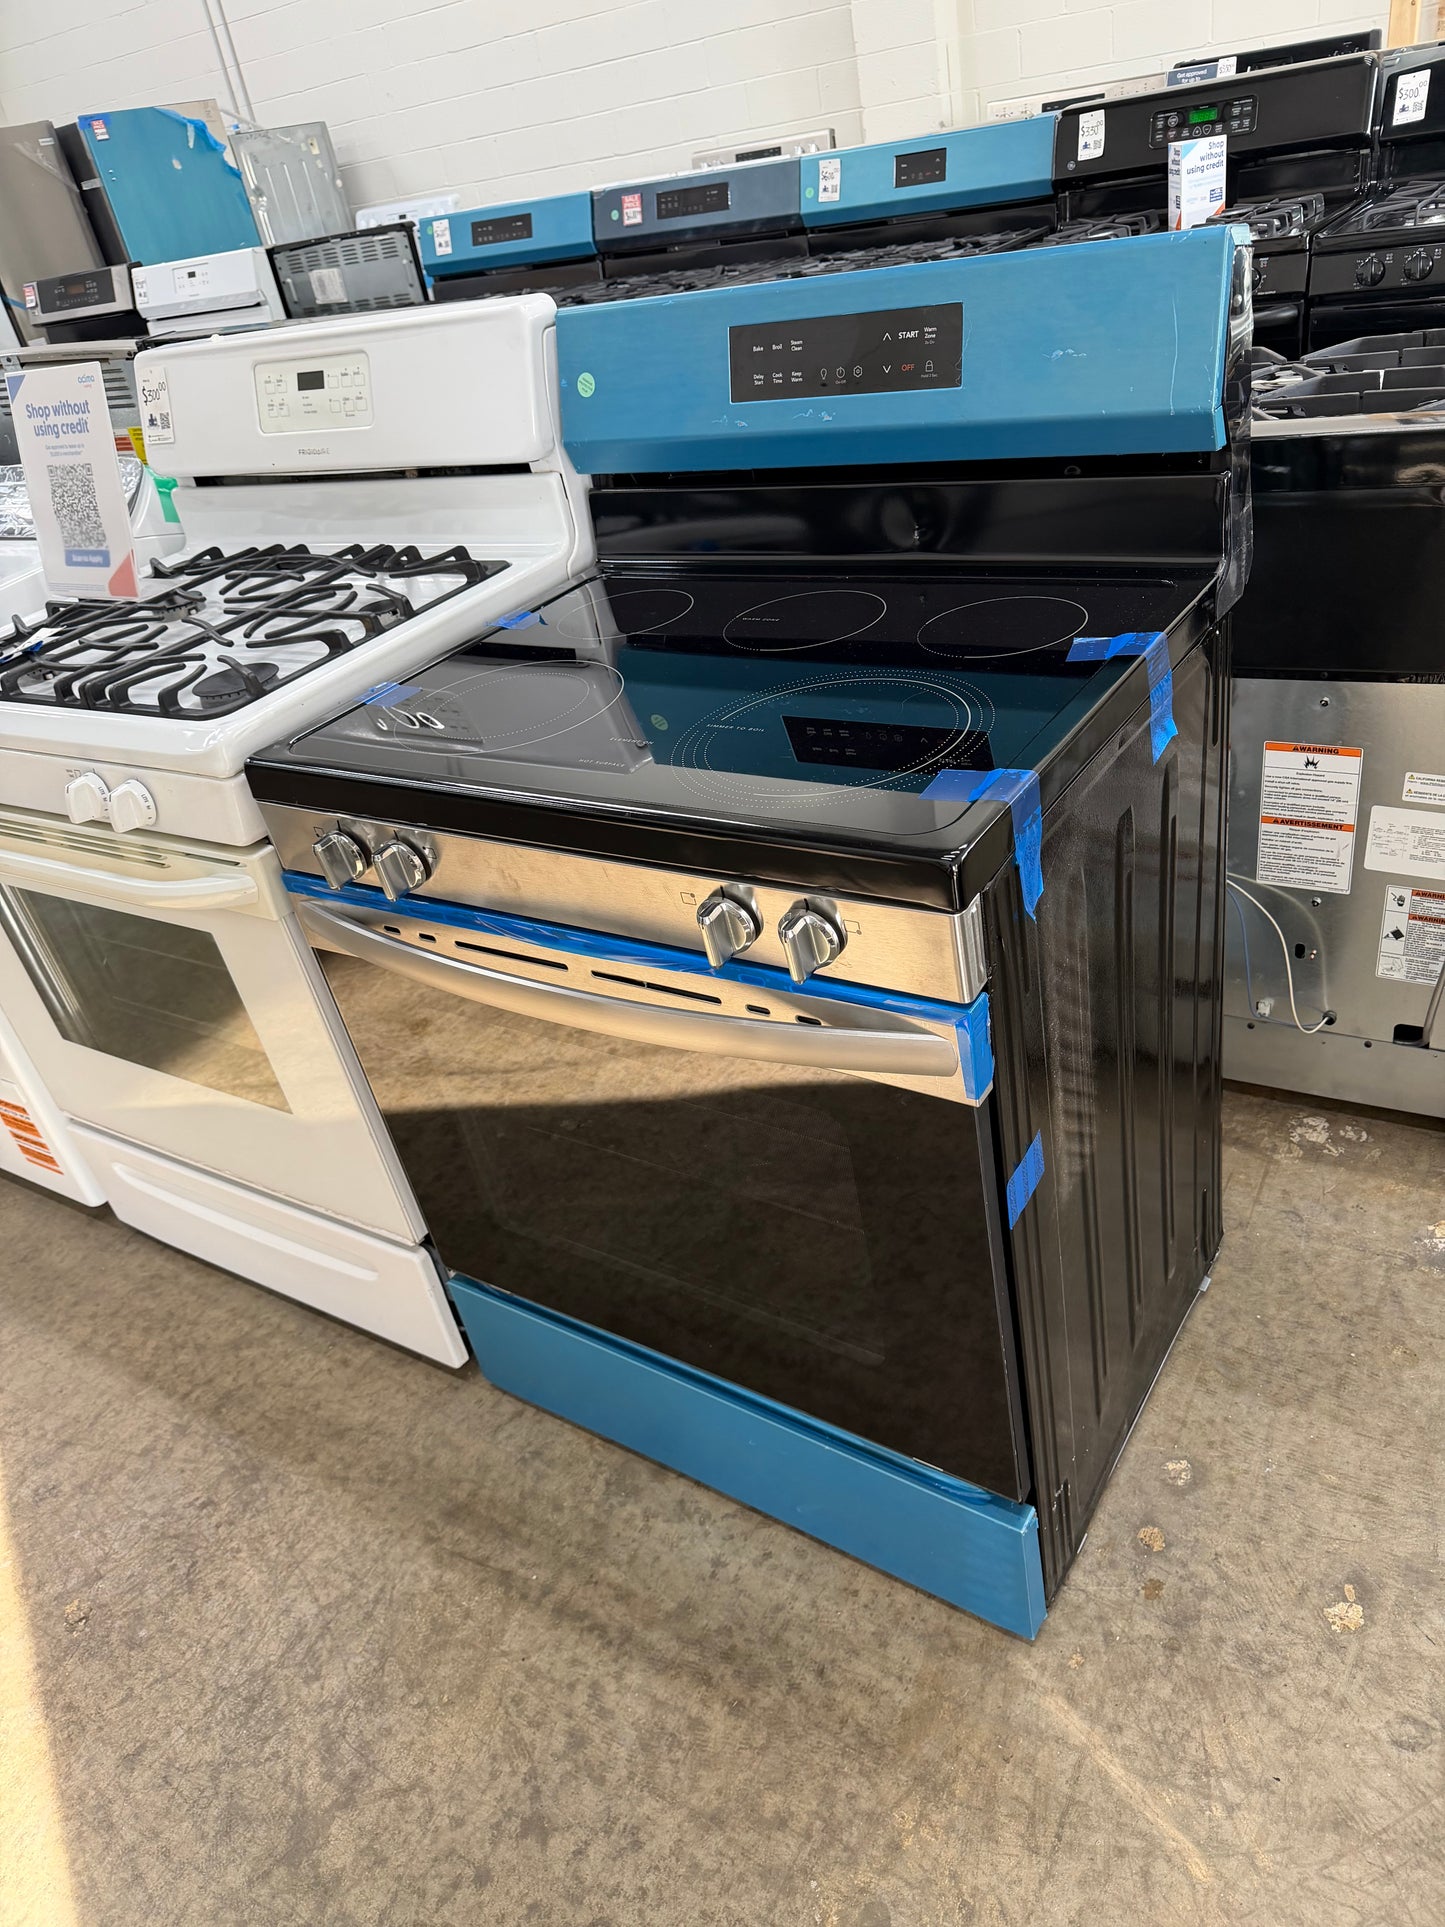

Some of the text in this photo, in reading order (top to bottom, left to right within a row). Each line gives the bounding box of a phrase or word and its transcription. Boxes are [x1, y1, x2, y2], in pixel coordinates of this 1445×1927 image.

[1208, 140, 1225, 150] Shop
[1199, 150, 1224, 162] without
[1186, 159, 1224, 175] using credit
[898, 330, 920, 340] START
[901, 363, 915, 372] OFF
[753, 373, 765, 381] Delay
[791, 370, 802, 378] Keep
[25, 399, 91, 421] Shop without
[34, 421, 60, 438] using
[1300, 746, 1340, 755] WARNING
[1280, 818, 1344, 830] AVERTISSEMENT
